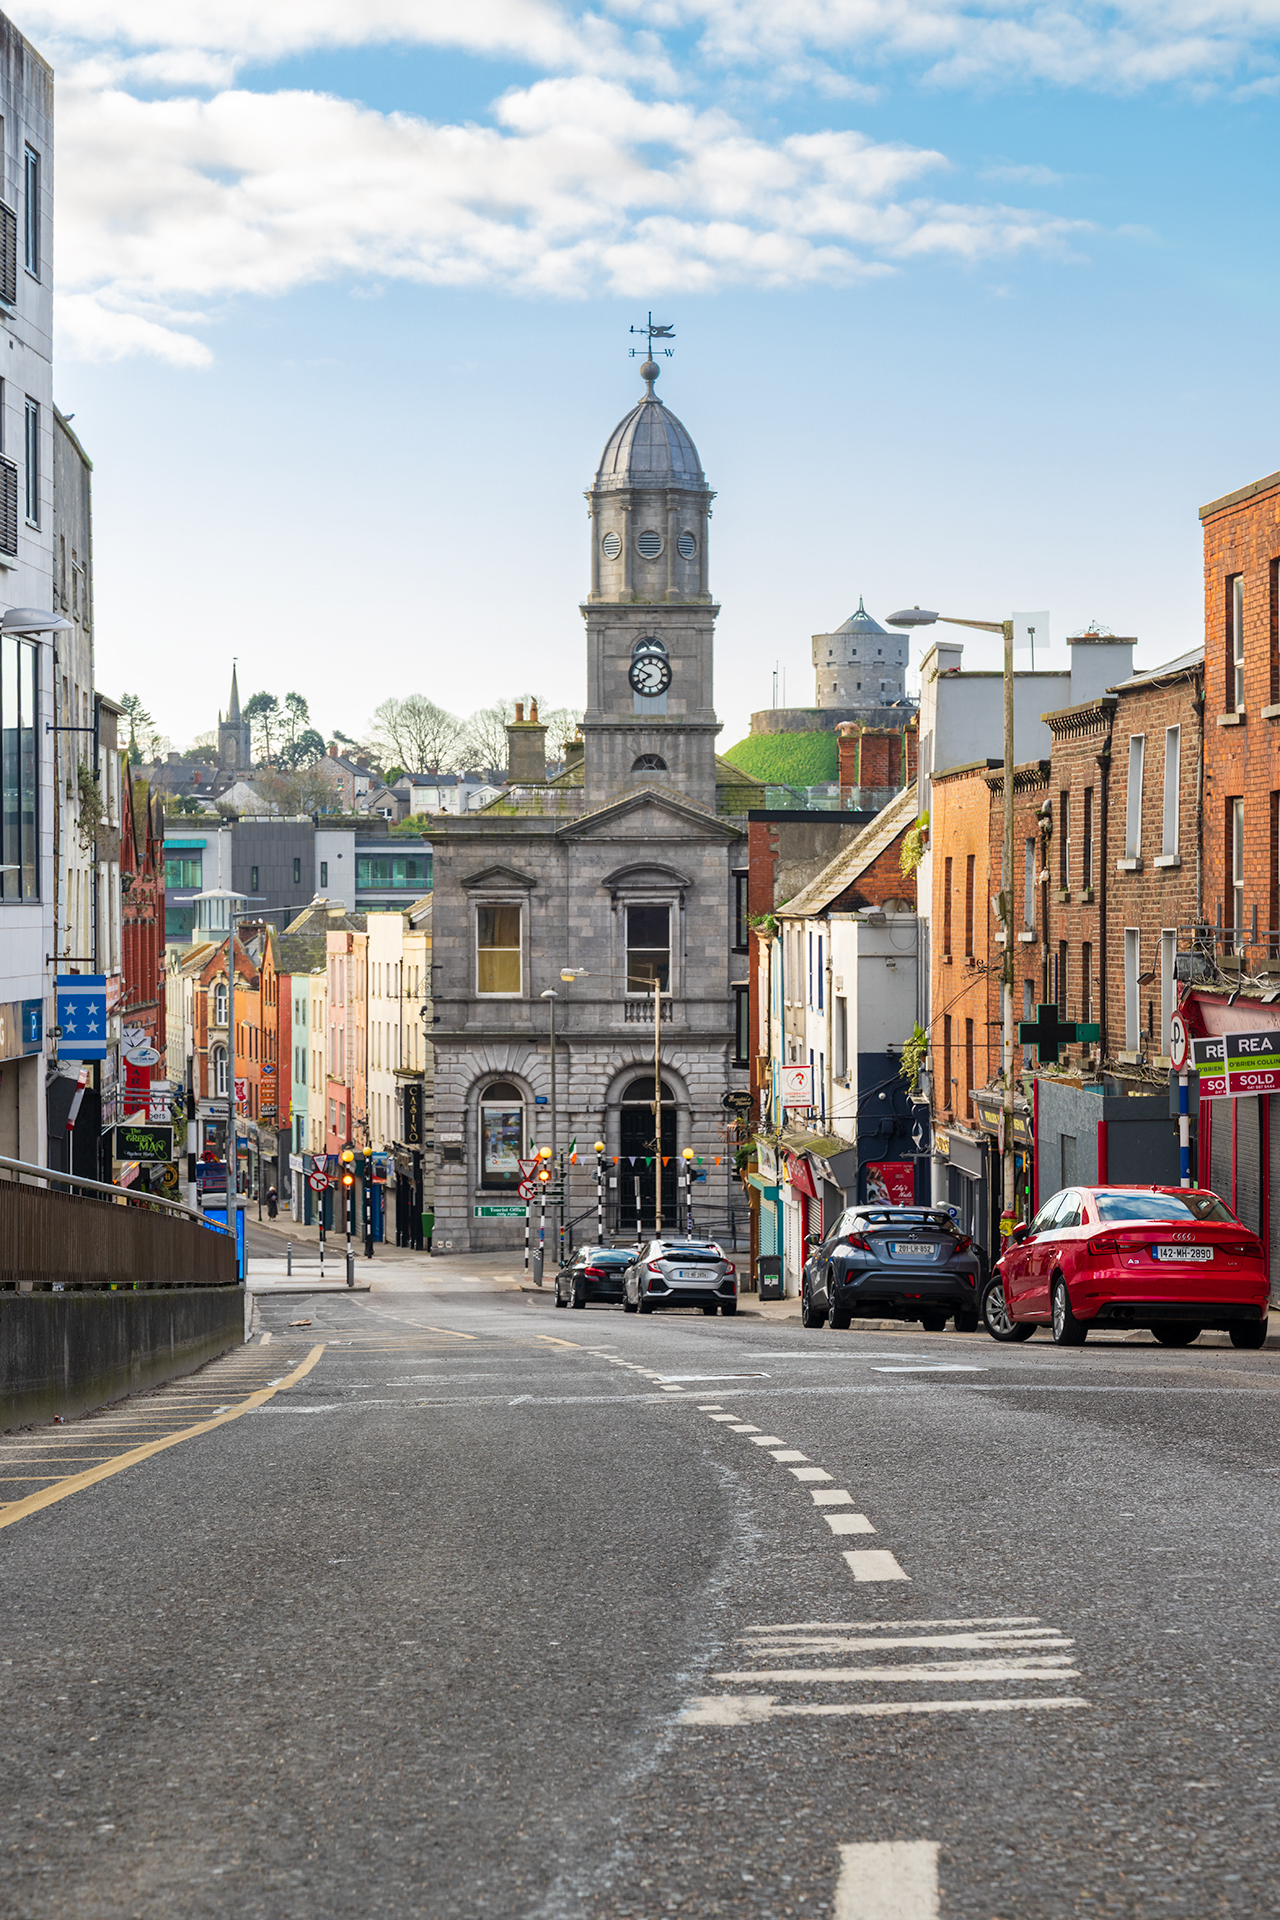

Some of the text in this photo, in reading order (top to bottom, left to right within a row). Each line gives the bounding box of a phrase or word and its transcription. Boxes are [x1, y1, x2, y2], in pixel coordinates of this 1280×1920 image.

[664, 348, 675, 357] W
[31, 1015, 36, 1037] P
[1173, 1022, 1181, 1059] P
[1238, 1037, 1273, 1053] REA
[1205, 1045, 1225, 1058] RE
[1197, 1065, 1223, 1073] O'BRIEN
[1229, 1059, 1256, 1068] O'BRIEN
[1207, 1080, 1227, 1091] SO
[1240, 1074, 1274, 1086] SOLD
[408, 1086, 418, 1142] CASINO
[126, 1133, 154, 1142] GREEN
[892, 1184, 908, 1192] Lily's
[949, 1209, 956, 1217] P
[898, 1244, 932, 1253] 201-LH-852
[1160, 1247, 1211, 1259] 142-MH-2890
